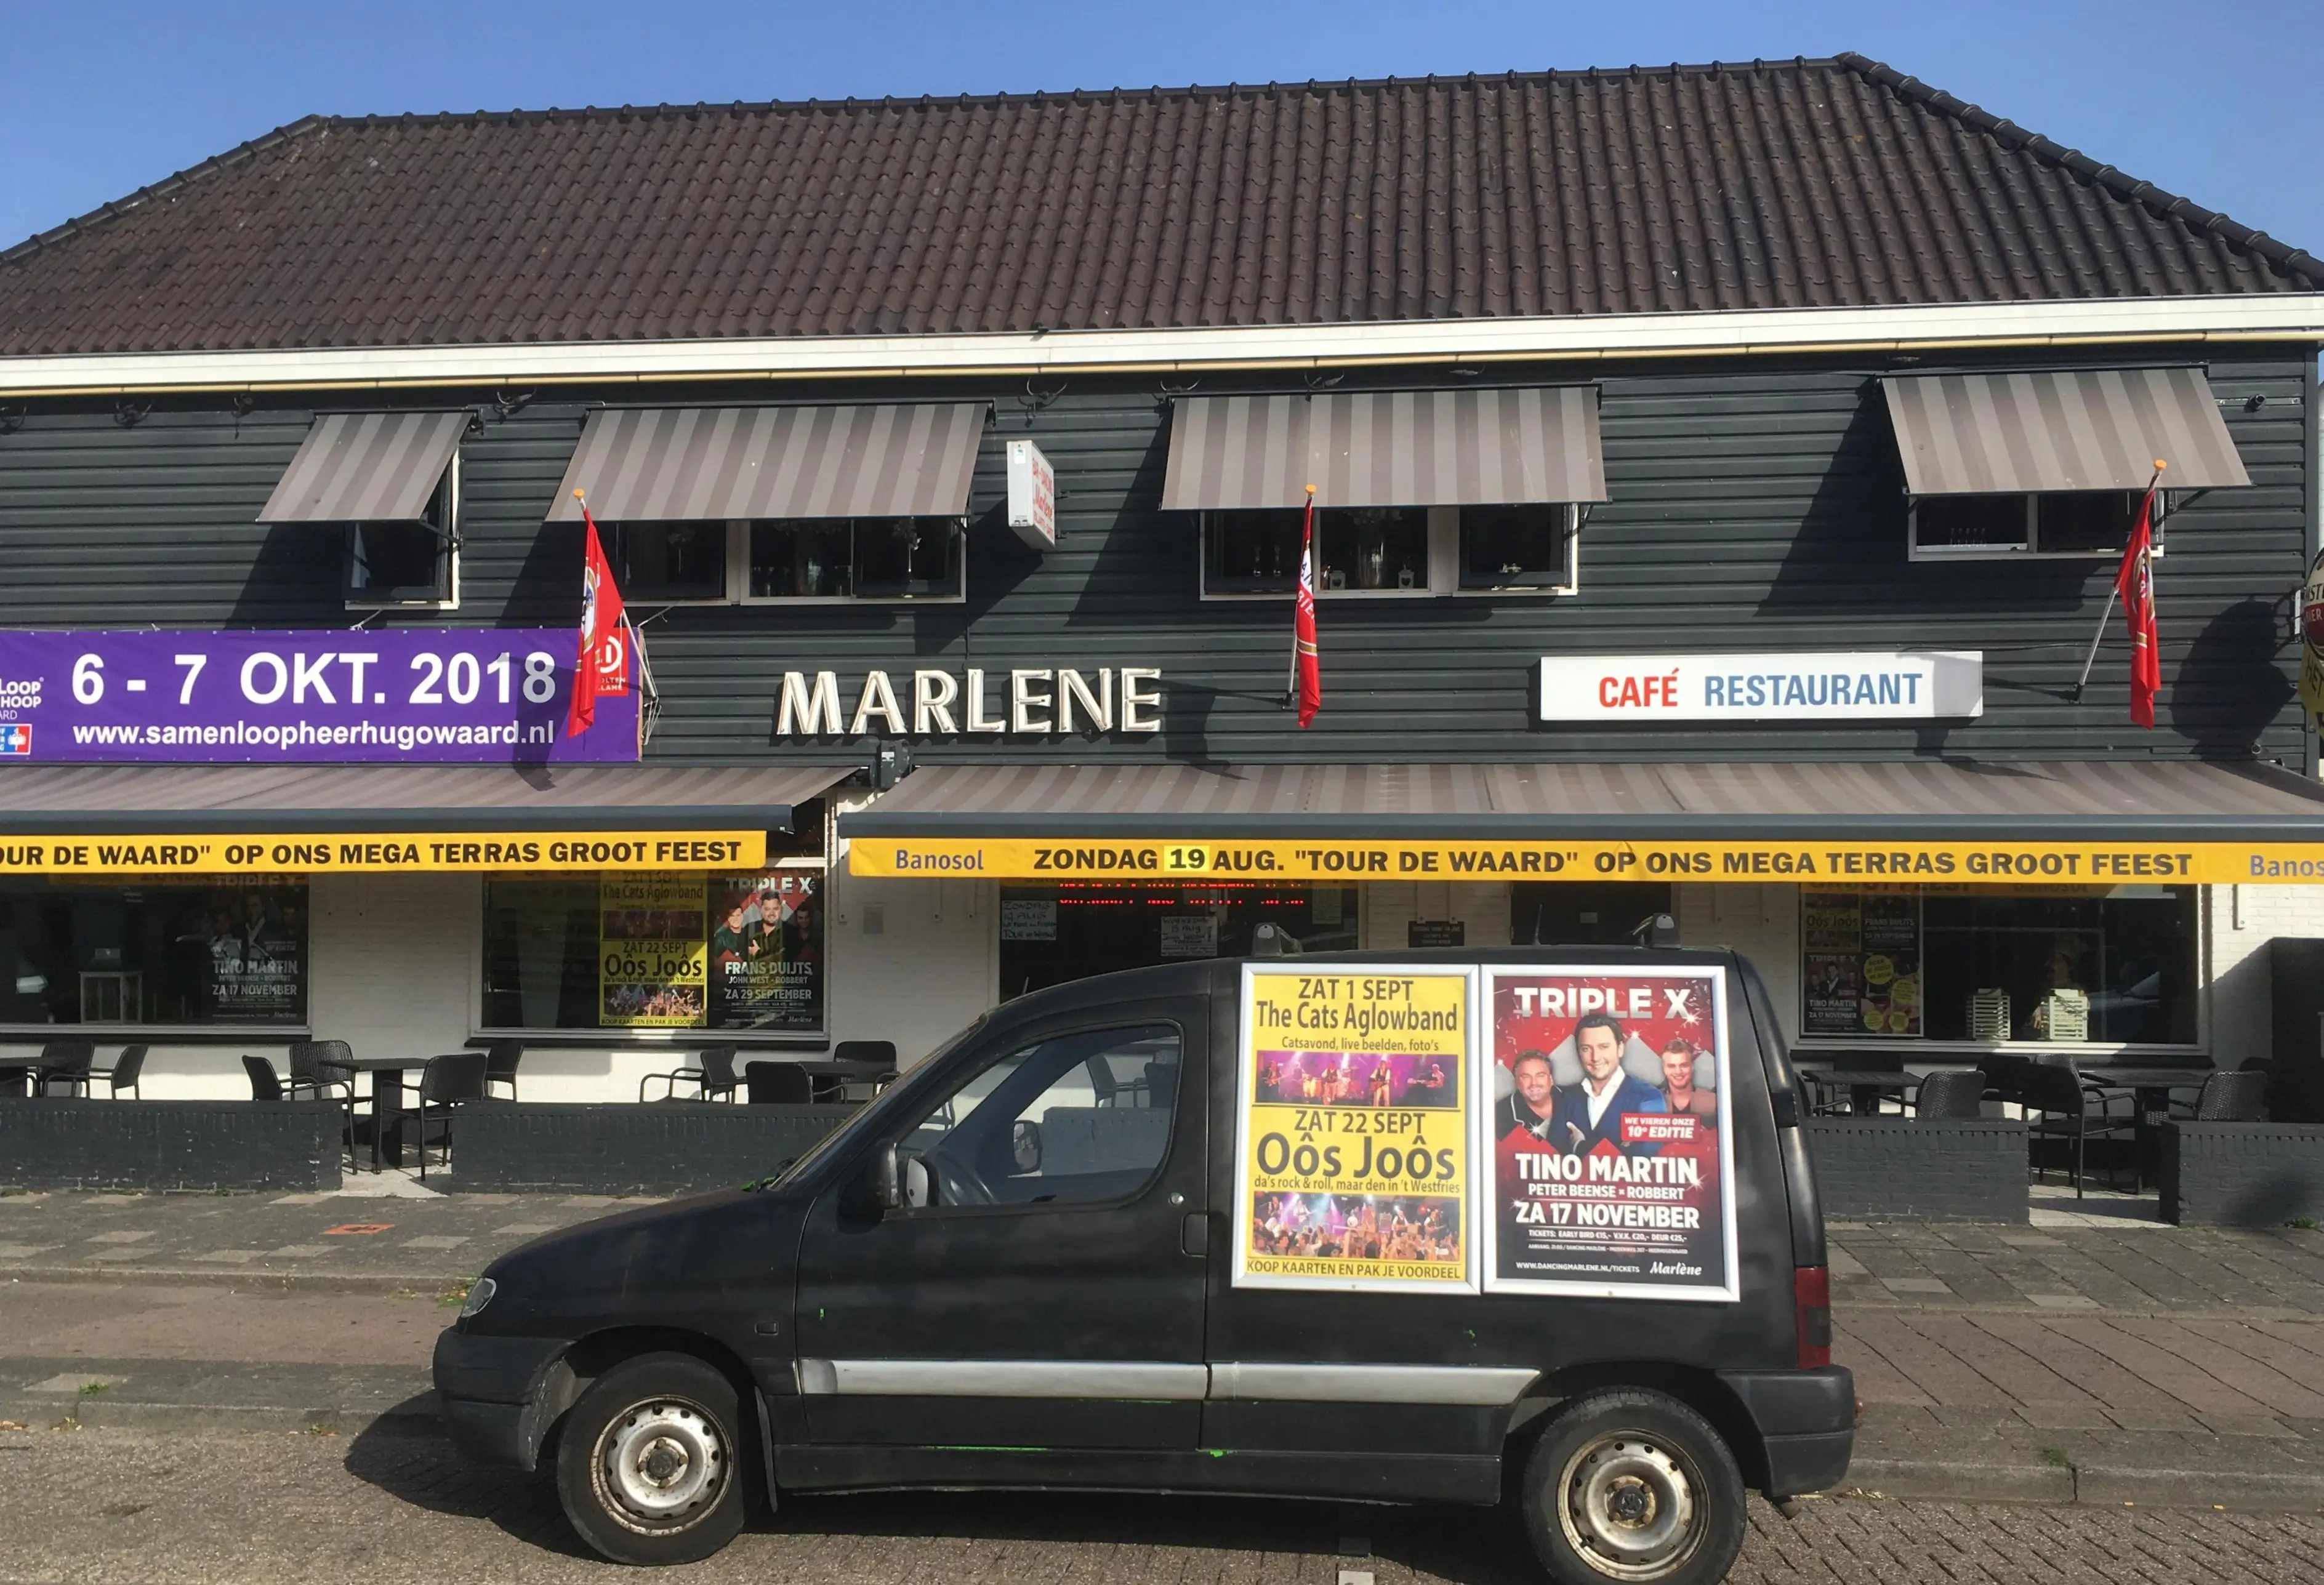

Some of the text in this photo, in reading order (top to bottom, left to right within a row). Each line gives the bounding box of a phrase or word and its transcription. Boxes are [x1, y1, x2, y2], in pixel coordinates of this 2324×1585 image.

[72, 651, 555, 704] 6 - 7 OKT. 2018
[1599, 667, 1923, 708] CAFÉ RESTAURANT
[776, 668, 1162, 735] MARLENE
[73, 720, 553, 750] www.samenloopheerhugowaard.nl
[0, 841, 741, 865] UR DE WAARD" OP ONS MEGA TERRAS GROOT FEEST
[896, 849, 984, 870] Banosol
[1034, 848, 1157, 870] ZONDAG
[1168, 848, 1205, 869] 19
[1212, 850, 1284, 871] AUG.
[1295, 850, 1388, 872] "TOUR
[1399, 851, 1438, 872] DE
[1448, 851, 1578, 872] WAARD"
[1594, 852, 1636, 873] OP
[1646, 852, 1712, 873] ONS
[1723, 852, 1816, 874] MEGA
[1826, 852, 1955, 875] TERRAS
[1966, 853, 2081, 875] GROOT
[2091, 853, 2192, 876] FEEST
[603, 884, 703, 902] The Cats Aglowband
[798, 877, 812, 893] X
[623, 942, 688, 953] ZAT 22 SEPT
[212, 960, 299, 974] TINO MARTIN
[605, 953, 702, 977] Oôs Joôs
[725, 961, 813, 975] FRANS DUIJTS
[728, 976, 748, 984] JOHN
[749, 976, 769, 984] WEST
[212, 984, 297, 996] ZA 17 NOVEMBER
[725, 989, 811, 1000] ZA 29 SEPTEMBER
[1298, 979, 1414, 1001] ZAT 1 SEPT
[1513, 987, 1691, 1019] TRIPLE X
[1256, 1000, 1457, 1037] The Cats Aglowband
[1282, 1037, 1439, 1053] Catsavond, live beelden, foto's
[1294, 1110, 1426, 1134] ZAT 22 SEPT
[1640, 1117, 1670, 1125] VIEREN
[1672, 1118, 1695, 1126] ONZE
[1649, 1126, 1695, 1139] EDITIE
[1257, 1132, 1455, 1180] Oôs Joôs
[1515, 1153, 1699, 1184] TINO MARTIN
[1254, 1175, 1460, 1193] da's rock & roll, maar den in 't Westfries
[1529, 1184, 1685, 1200] PETER BEENSE ROBBERT
[1515, 1202, 1700, 1229] ZA 17 NOVEMBER
[1529, 1230, 1556, 1238] TICKETS:
[1558, 1230, 1578, 1239] EARLY
[1579, 1231, 1594, 1239] BIRD
[1247, 1261, 1460, 1279] KOOP KAARTEN EN PAK JE VOORDEEL
[1516, 1261, 1702, 1276] WWW.DANCINGMARLENE.NL/TICKETS Marlène
